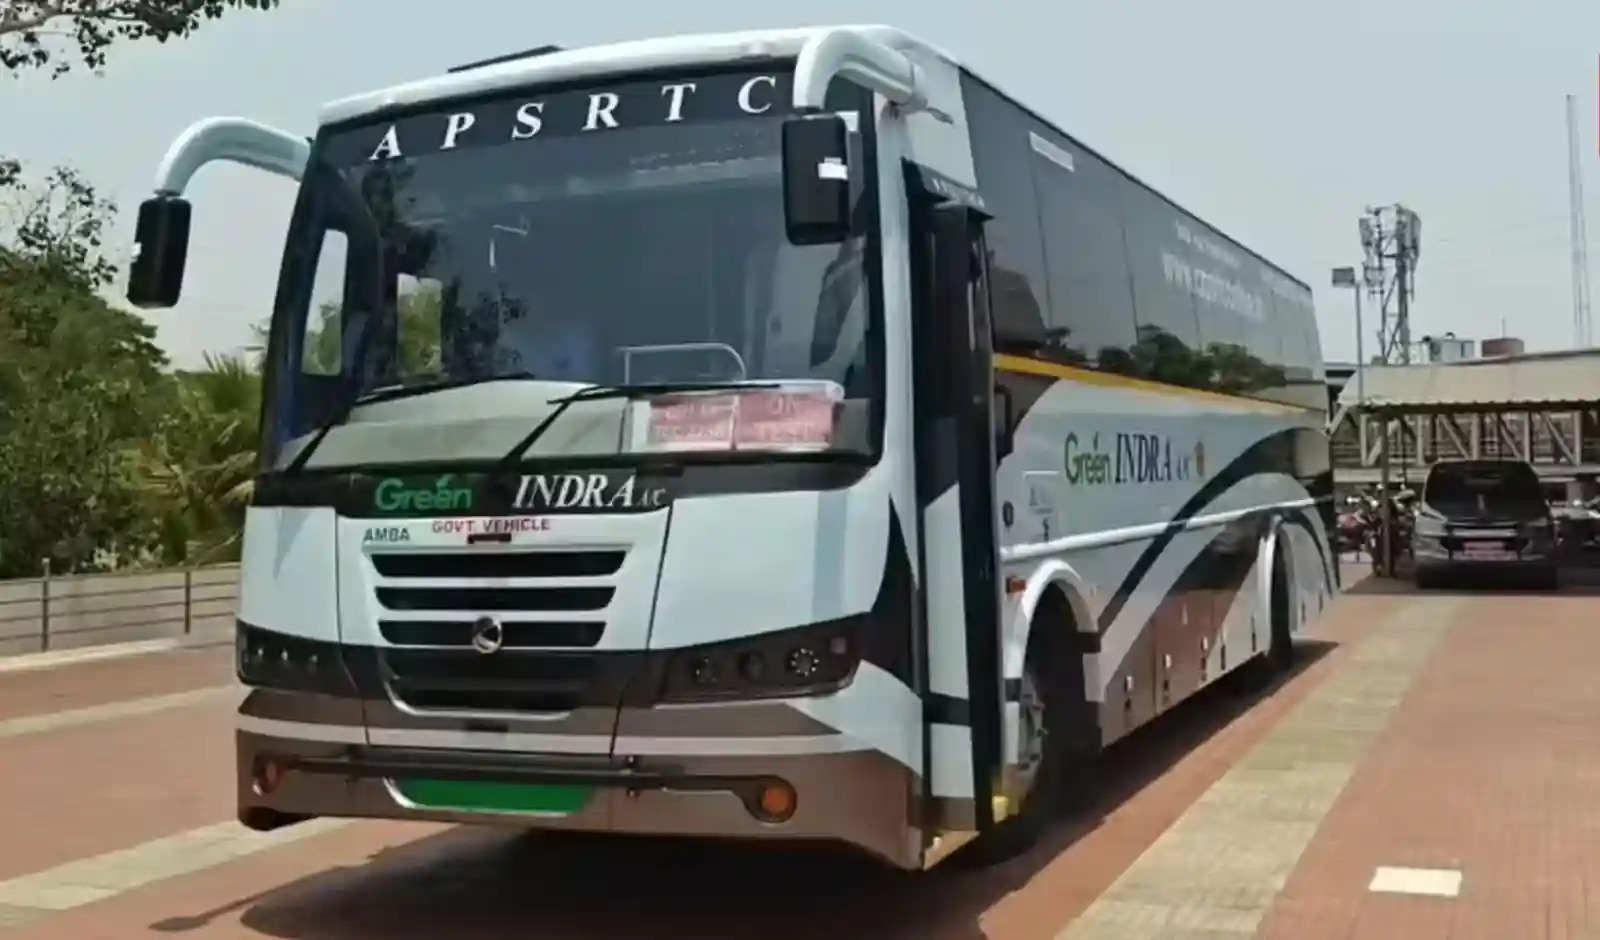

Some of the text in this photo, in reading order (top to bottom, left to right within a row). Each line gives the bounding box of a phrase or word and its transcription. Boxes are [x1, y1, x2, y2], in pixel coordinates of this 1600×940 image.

[1064, 431, 1111, 485] Green
[1115, 432, 1172, 484] INDRA
[374, 472, 473, 511] Green
[511, 474, 637, 509] INDRA
[483, 517, 551, 532] VEHICLE
